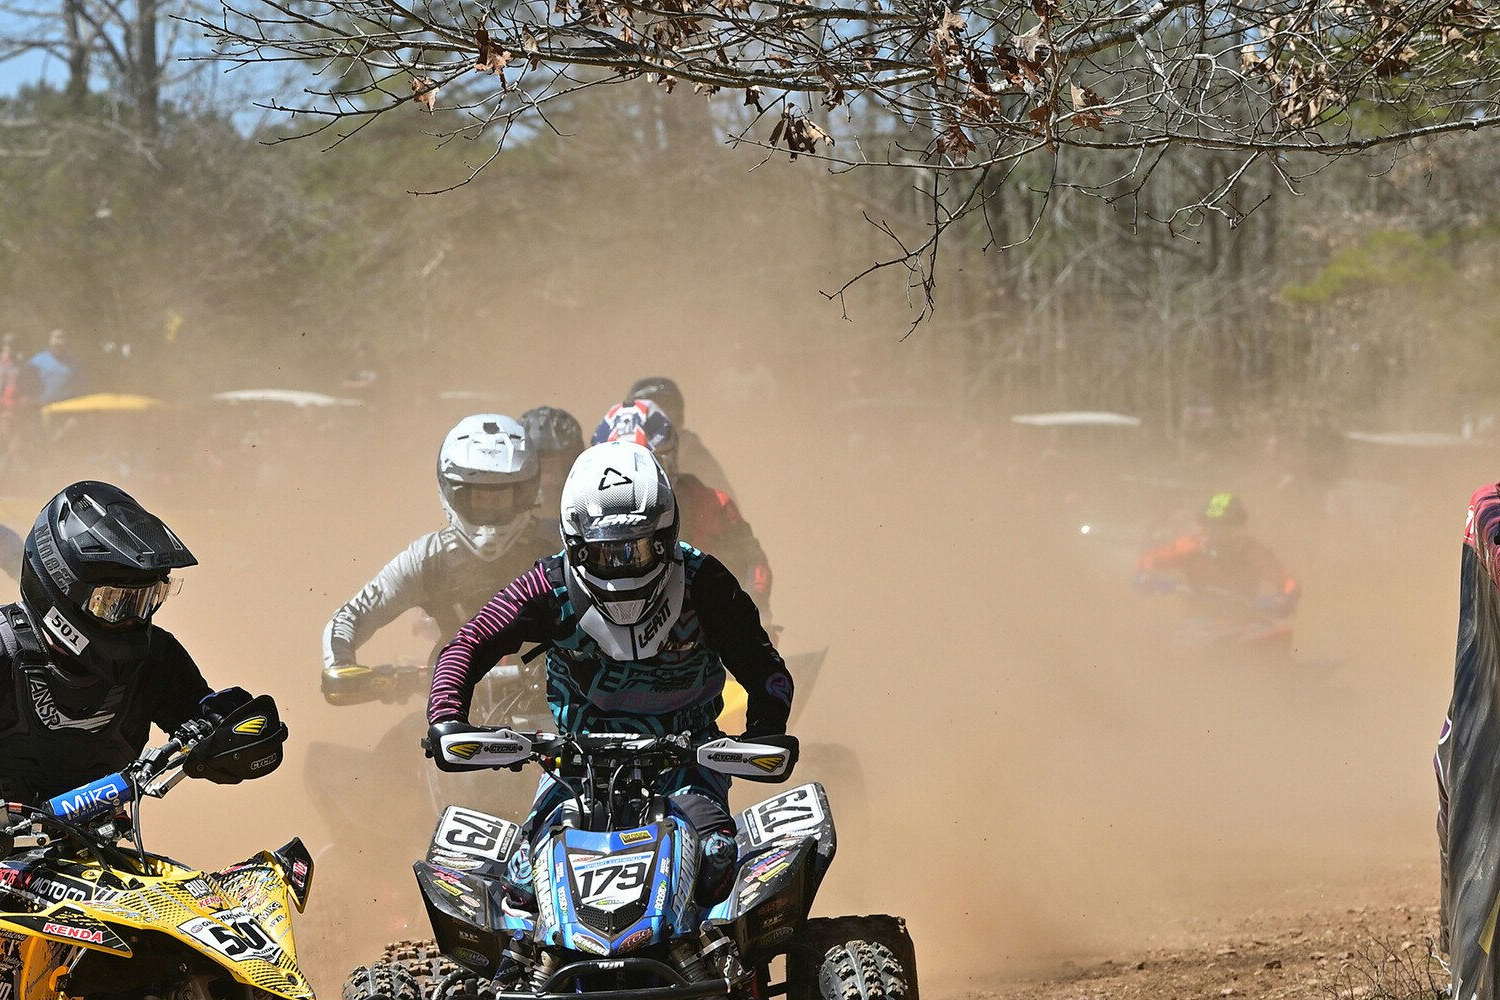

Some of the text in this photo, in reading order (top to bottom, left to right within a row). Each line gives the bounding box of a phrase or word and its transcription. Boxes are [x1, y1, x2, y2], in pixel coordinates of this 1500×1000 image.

[590, 513, 647, 528] LEATT
[51, 614, 81, 647] 501
[637, 599, 671, 649] LEATT
[489, 744, 519, 754] CYCRA
[713, 753, 742, 763] CYCRA
[61, 783, 119, 821] Mika
[757, 789, 815, 833] 179
[446, 811, 504, 852] 179
[579, 862, 648, 900] 179
[672, 827, 695, 916] DEMAREE
[43, 922, 104, 944] KENDA
[209, 918, 279, 957] 501
